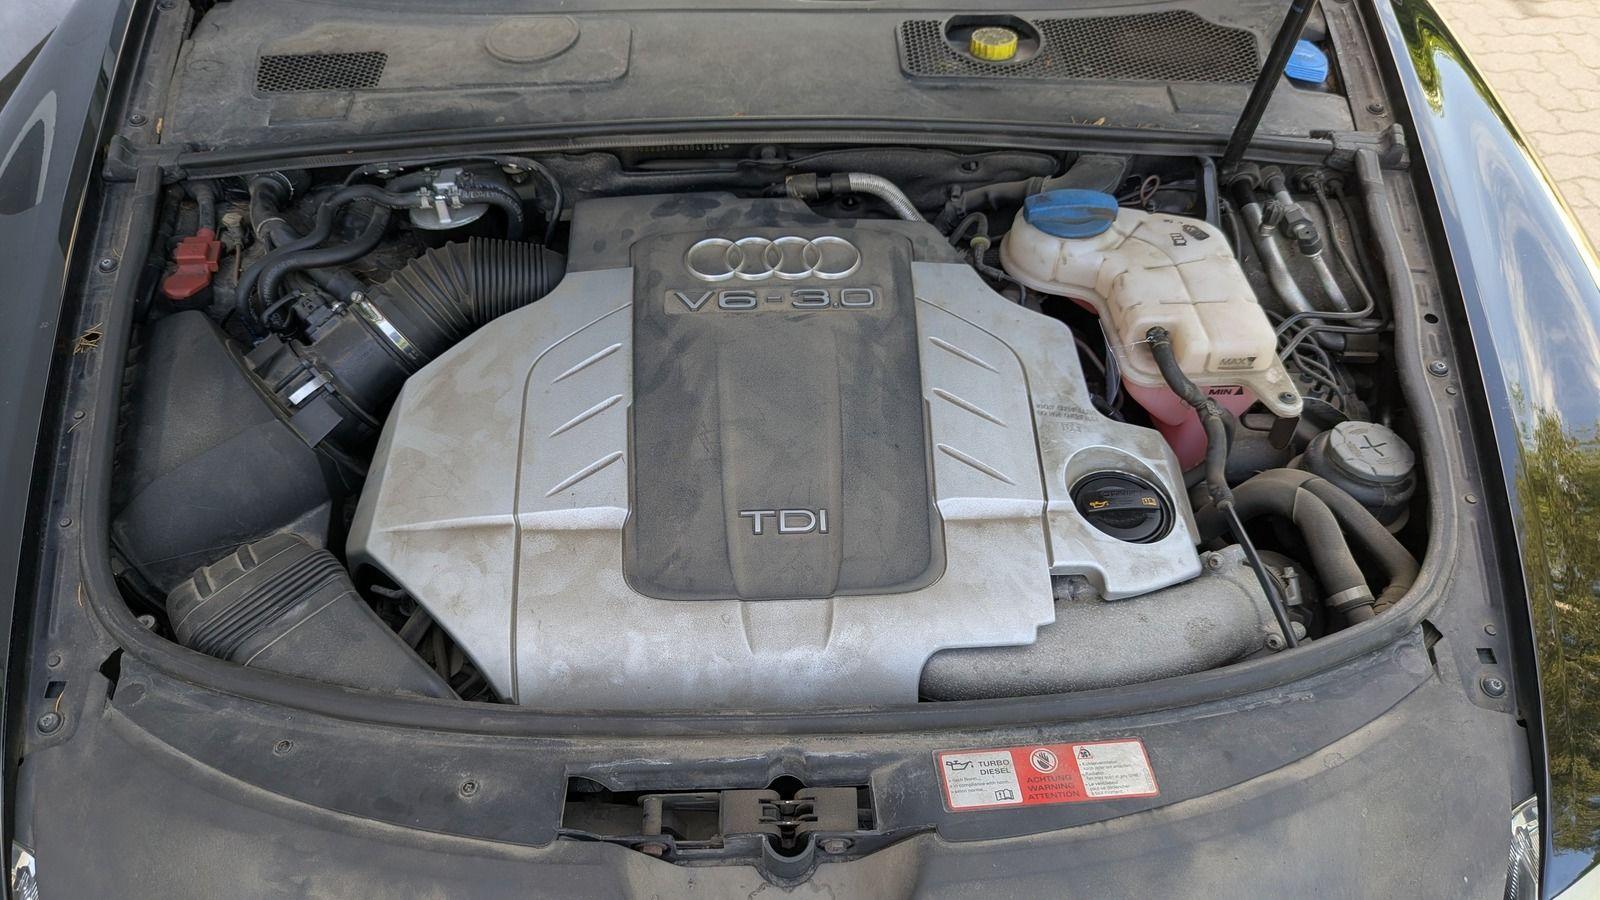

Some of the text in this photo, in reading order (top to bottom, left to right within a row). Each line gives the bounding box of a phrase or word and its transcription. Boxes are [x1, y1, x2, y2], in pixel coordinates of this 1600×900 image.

[1219, 357, 1247, 366] MAX
[1208, 388, 1232, 396] MIN
[738, 508, 829, 535] TDI
[978, 759, 1010, 768] TURBO
[979, 767, 1011, 776] DIESEL
[1027, 774, 1072, 784] ACHTUNG
[1027, 782, 1076, 792] WARNING
[1028, 790, 1080, 800] ATTENTION
